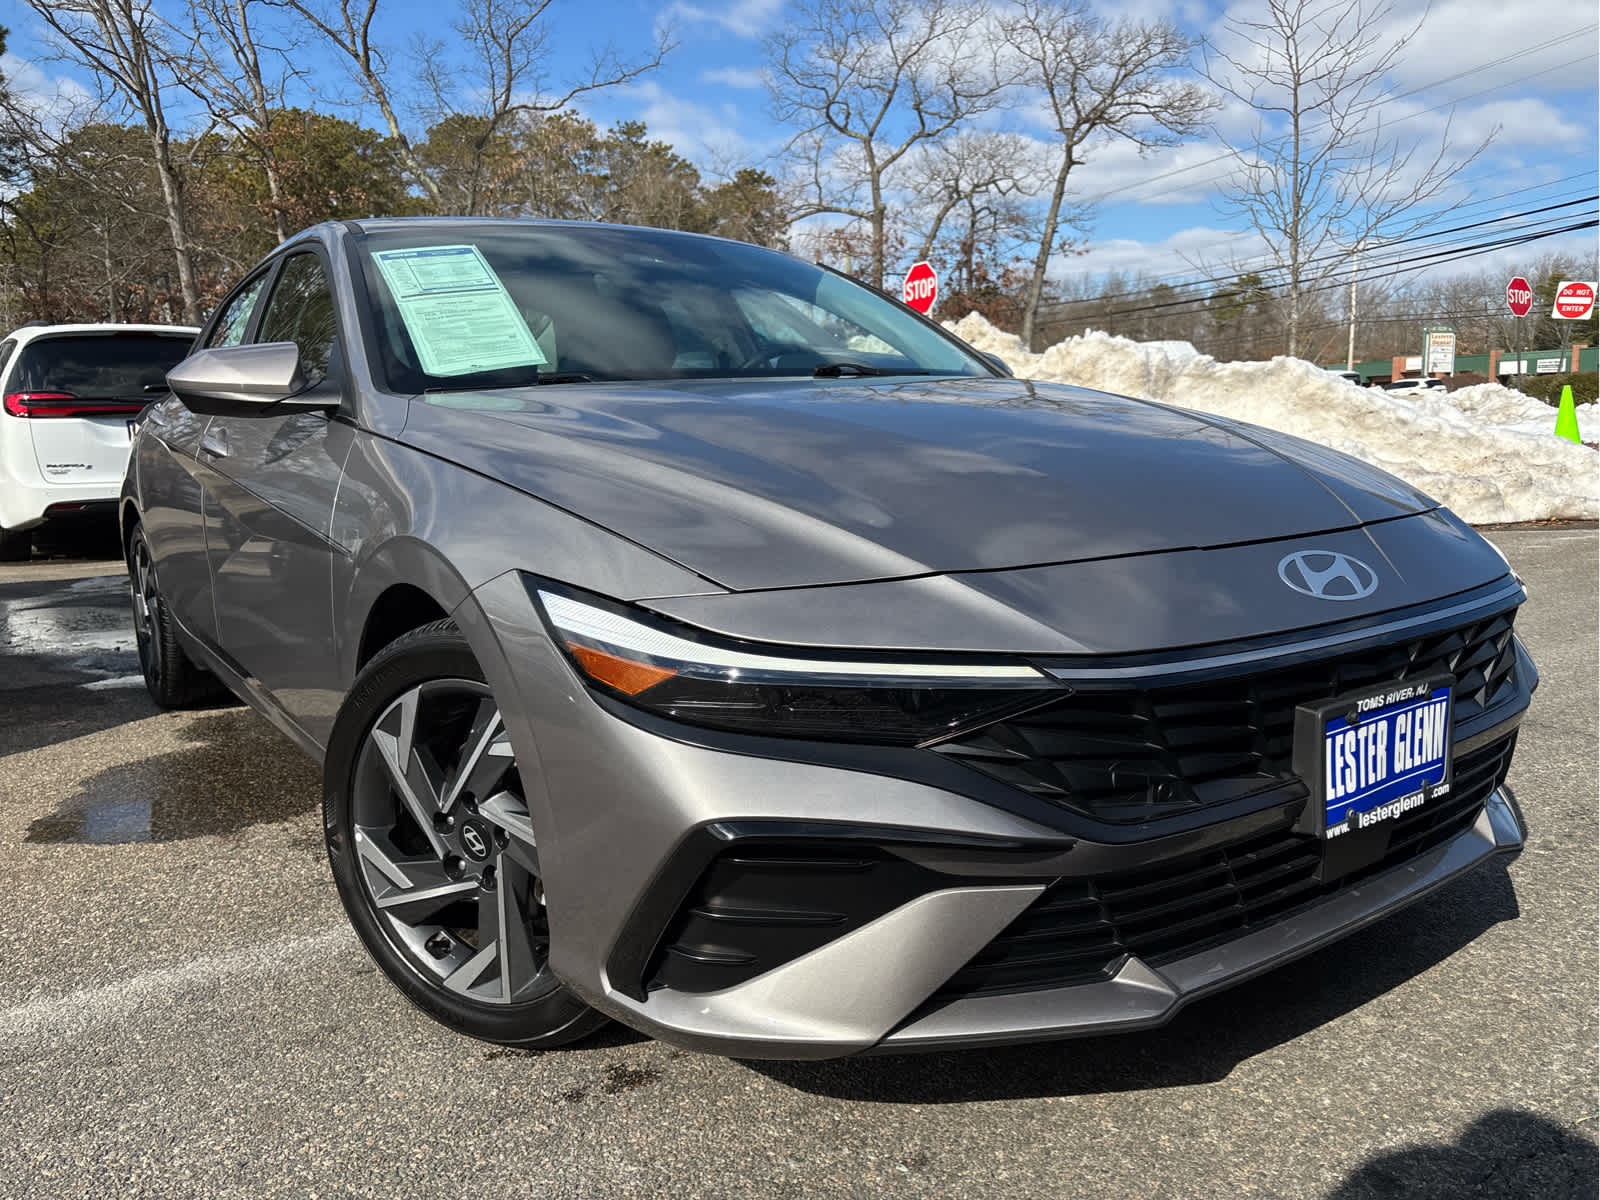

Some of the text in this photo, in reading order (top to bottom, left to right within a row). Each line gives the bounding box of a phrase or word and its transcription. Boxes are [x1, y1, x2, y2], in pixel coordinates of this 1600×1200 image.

[906, 277, 935, 301] STOP
[1509, 289, 1531, 304] STOP
[1357, 695, 1385, 713] TOMS
[1416, 683, 1429, 695] NJ
[1326, 702, 1447, 801] LESTER GLENN
[1326, 785, 1450, 840] www. lesterglenn .com
